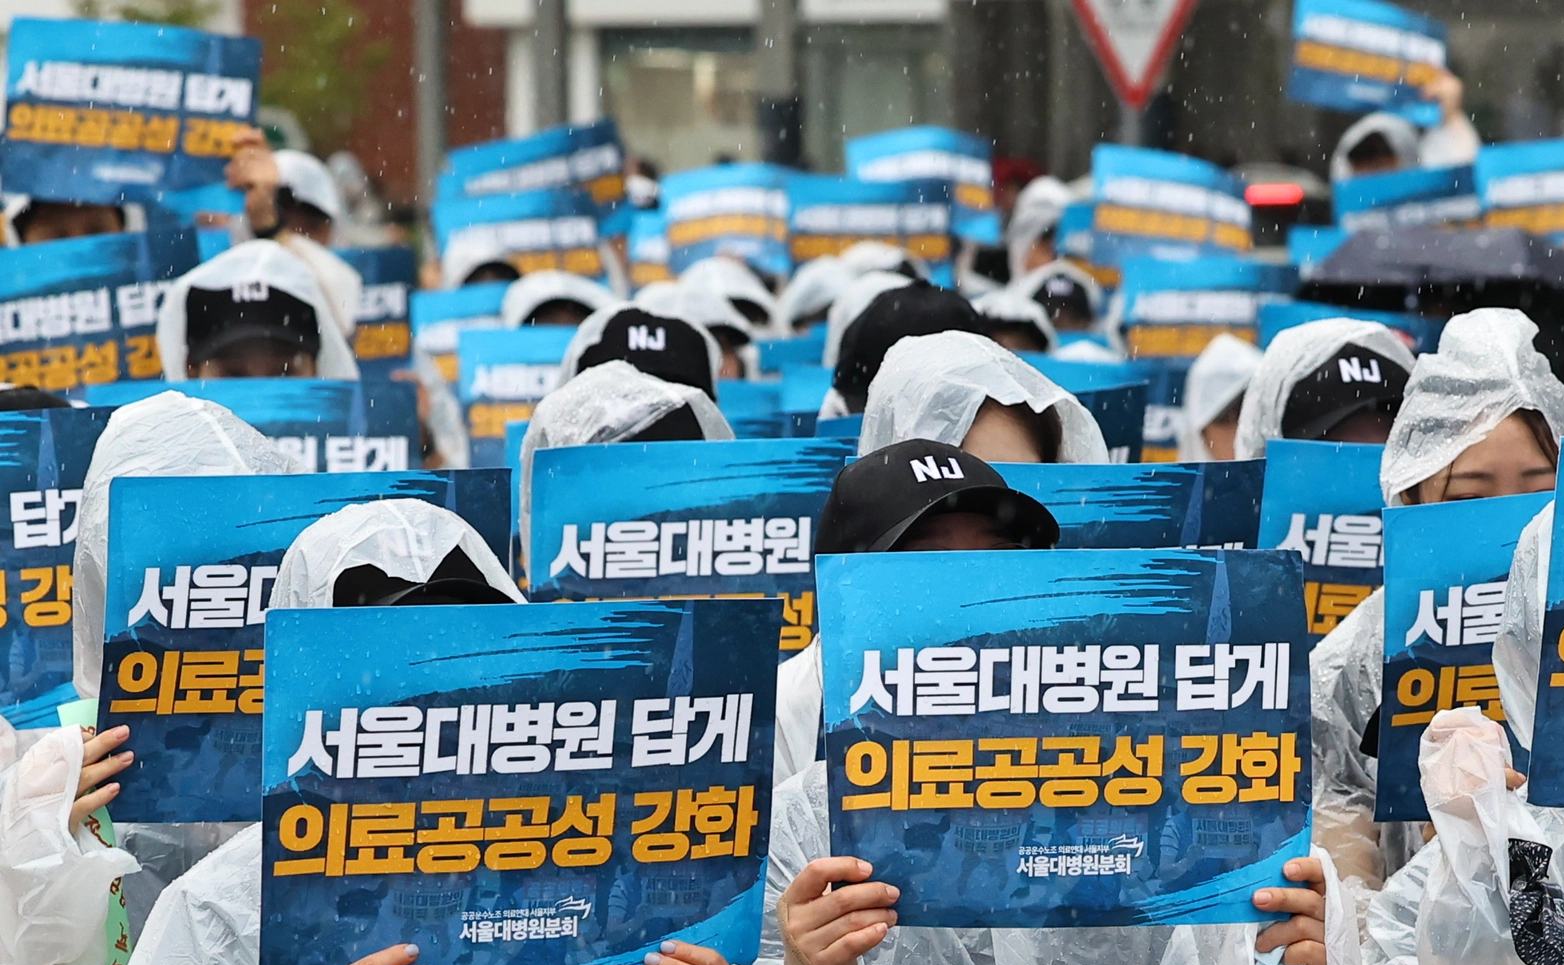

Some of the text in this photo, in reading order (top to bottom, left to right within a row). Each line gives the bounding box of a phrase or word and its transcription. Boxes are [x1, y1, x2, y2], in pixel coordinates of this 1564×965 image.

[0, 285, 112, 344] 대병원
[628, 325, 666, 350] NJ
[0, 338, 118, 391] 공공성
[1338, 357, 1381, 383] NJ
[325, 434, 408, 472] 답게
[910, 456, 964, 482] NJ
[551, 517, 810, 578] 서울대병원
[1276, 513, 1383, 568] 서울
[851, 643, 1289, 715] 서울대병원 답게
[289, 694, 753, 778] 서울대병원 답게
[844, 732, 1301, 810] 의료공공성 강화
[274, 786, 758, 876] 의료공공성 강화
[1018, 846, 1057, 855] 공공운수노조
[1016, 852, 1131, 877] 서울대병원분회
[459, 915, 578, 943] 서울대병원분회
[461, 910, 501, 921] 공공운수노조
